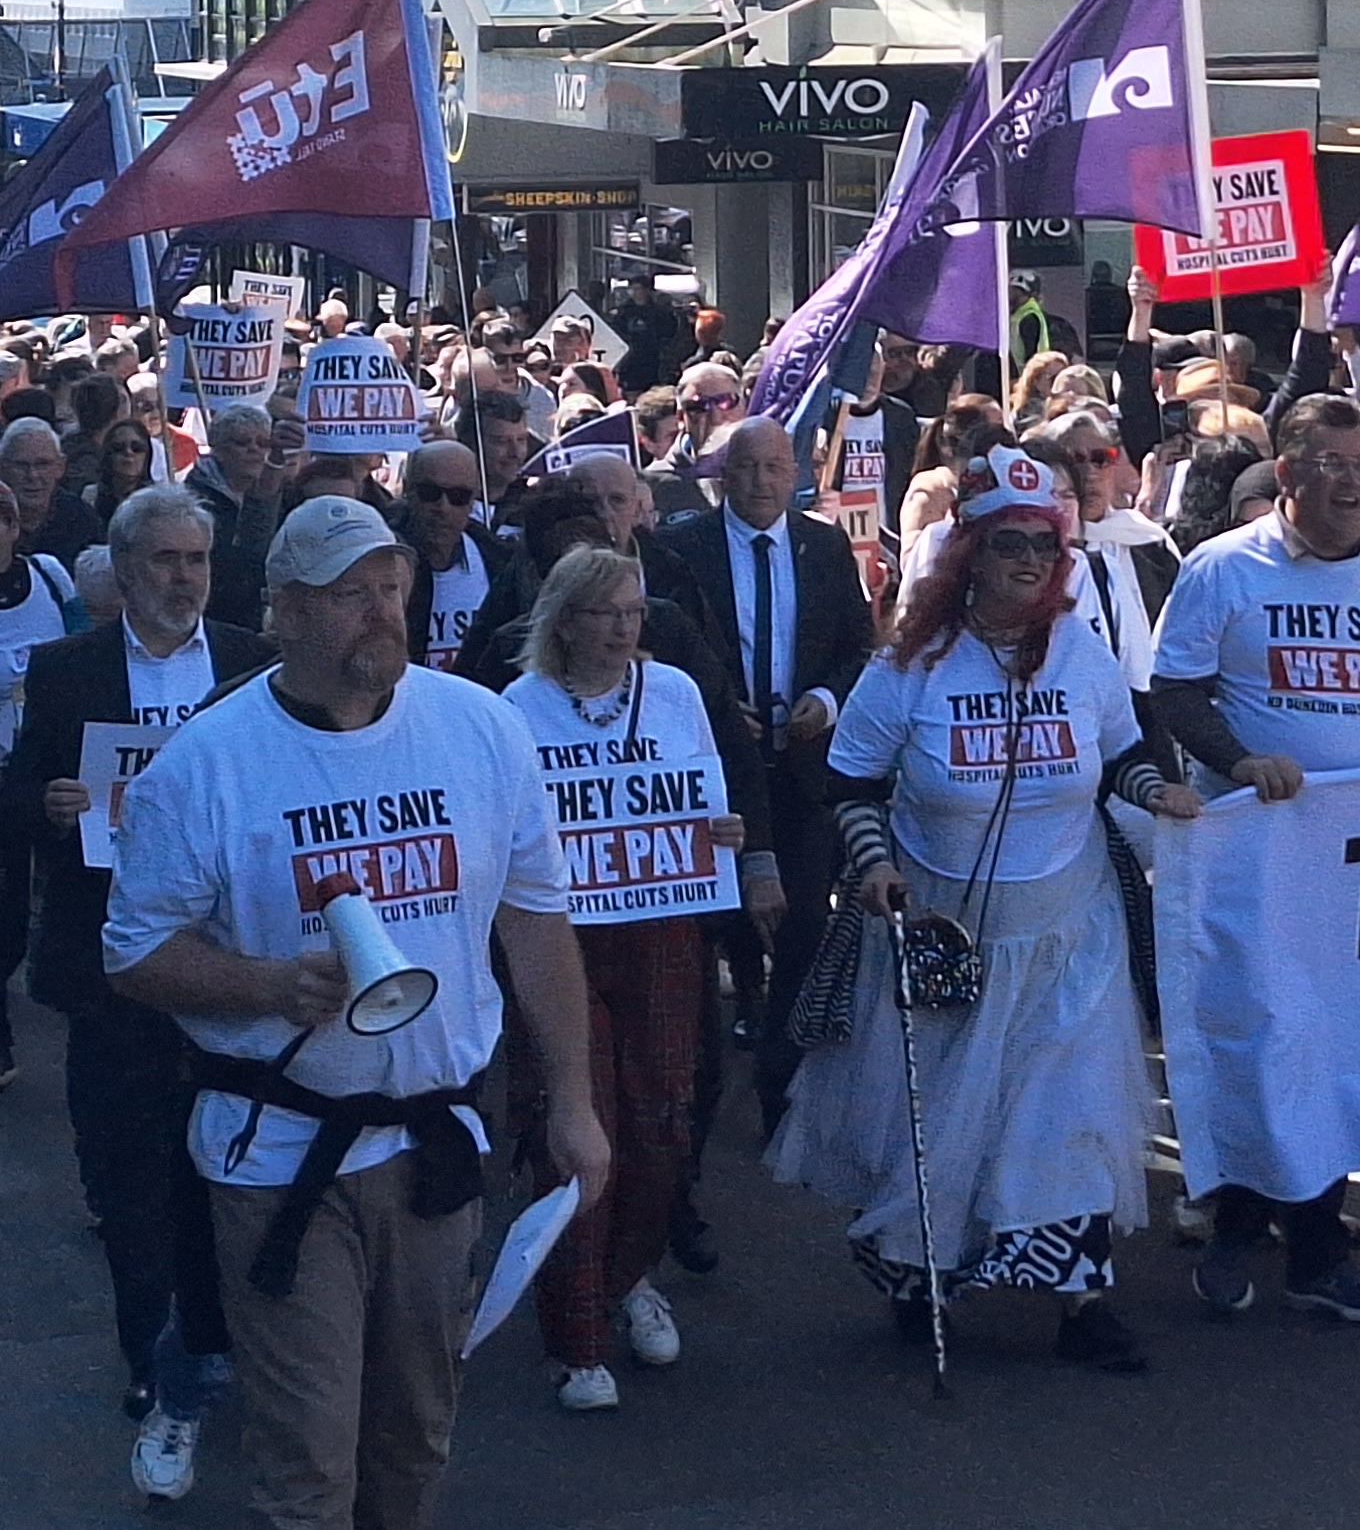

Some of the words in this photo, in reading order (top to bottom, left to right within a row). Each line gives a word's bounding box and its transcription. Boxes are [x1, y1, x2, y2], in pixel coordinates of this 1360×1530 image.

[554, 72, 587, 110] VIVO
[759, 74, 889, 117] VIVO
[758, 120, 809, 134] HAIR
[819, 118, 889, 132] SALON
[706, 149, 773, 171] VIVO
[1230, 169, 1280, 201] SAVE
[1006, 217, 1070, 238] IVO
[1229, 205, 1274, 245] PAY
[1177, 250, 1229, 271] HOSPIAL
[190, 319, 232, 343] THEY
[234, 319, 274, 343] SAVE
[229, 348, 267, 379] PAY
[313, 355, 362, 381] THEY
[317, 387, 359, 418] WE
[363, 387, 406, 418] PAY
[307, 423, 356, 435] HOSPITAL
[359, 423, 387, 435] CUTS
[1263, 604, 1340, 639] THEY
[1280, 649, 1342, 689] WE
[1014, 688, 1069, 720] SAVE
[537, 742, 599, 770] THEY
[1016, 723, 1063, 761] PAY
[625, 770, 708, 816] SAVE
[282, 798, 368, 847] THEY
[377, 789, 452, 833] SAVE
[378, 838, 443, 896] PAY
[562, 832, 620, 886] WE
[623, 825, 694, 880] PAY
[381, 902, 420, 923] CUTS
[423, 895, 459, 917] HURT
[567, 892, 621, 914] SPITAL
[623, 886, 669, 908] CUTS
[672, 880, 718, 903] HURT
